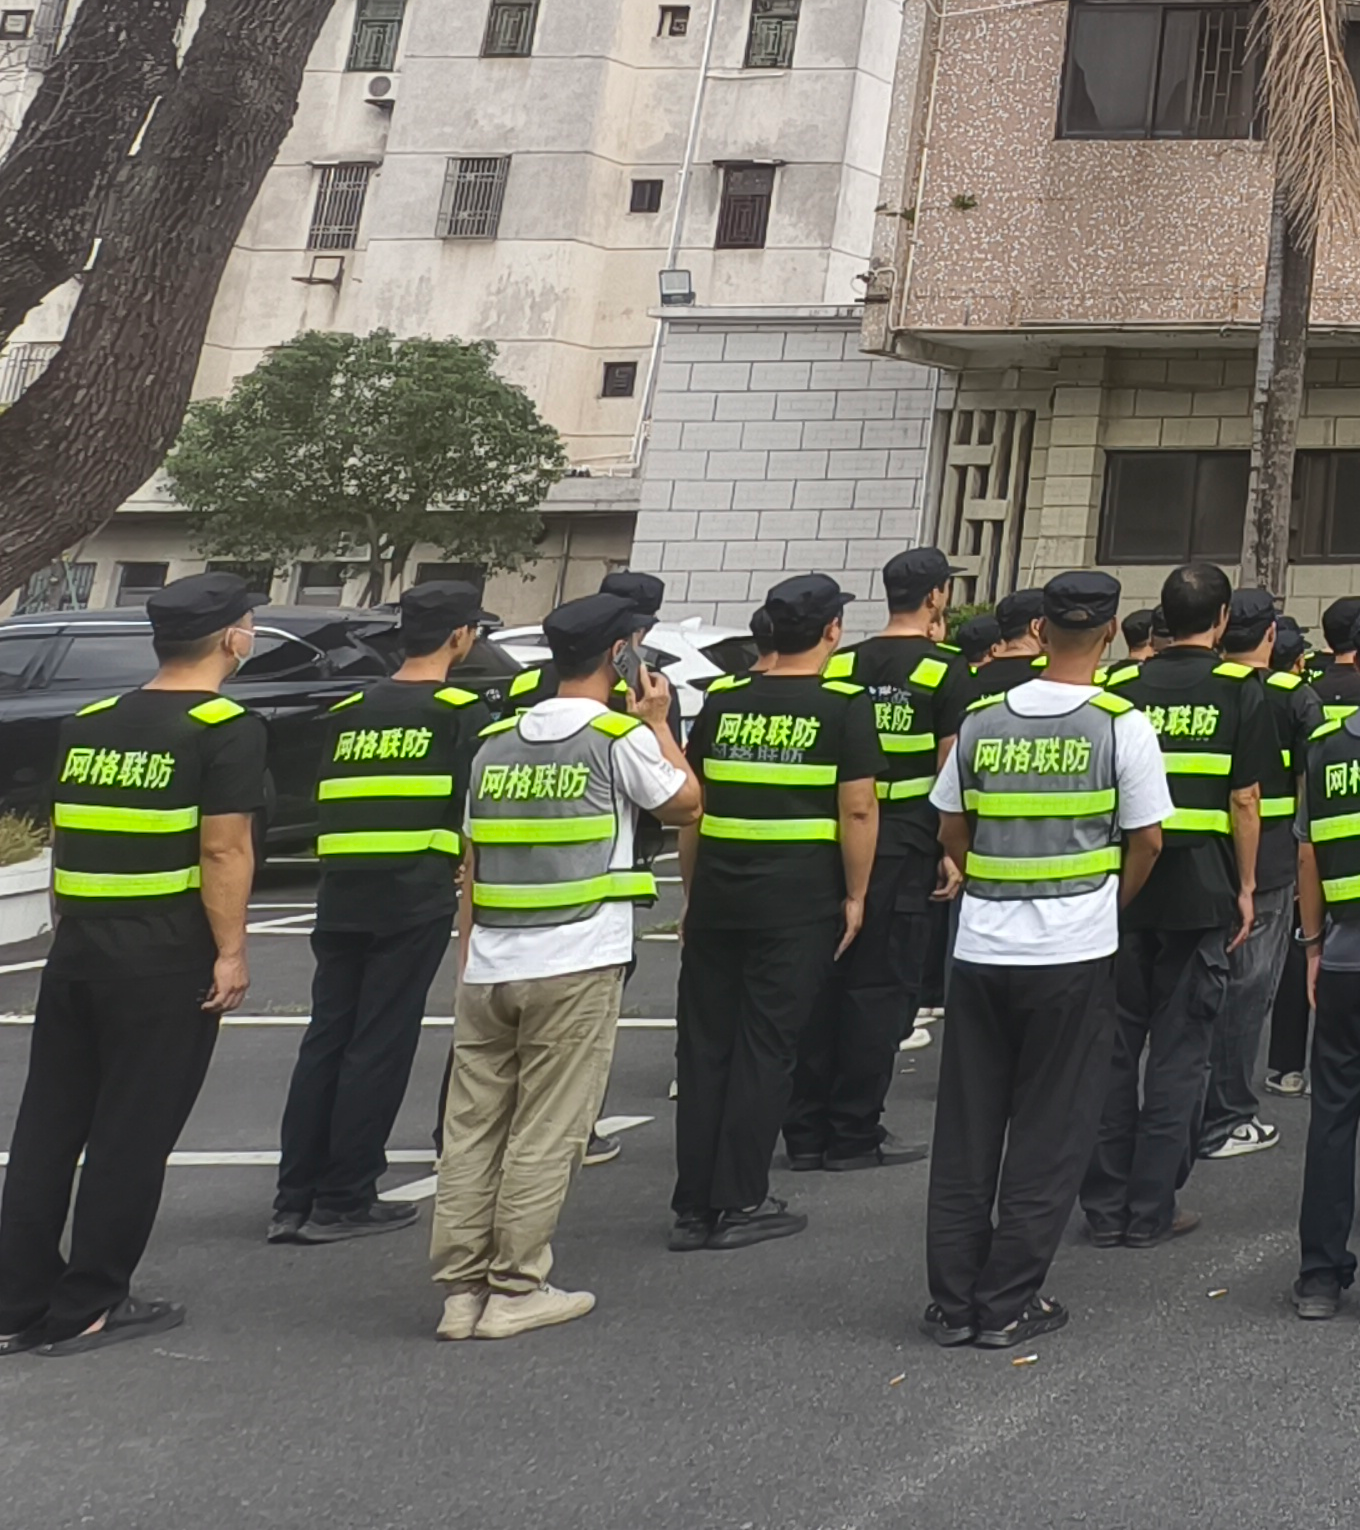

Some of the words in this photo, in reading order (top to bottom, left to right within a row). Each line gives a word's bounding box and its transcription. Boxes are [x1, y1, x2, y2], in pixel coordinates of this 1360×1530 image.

[333, 727, 433, 762] 网格联防
[716, 713, 821, 748] 网格联防
[61, 748, 175, 788] 网格联防
[974, 737, 1092, 773] 网格联防
[478, 762, 590, 800] 网格联防
